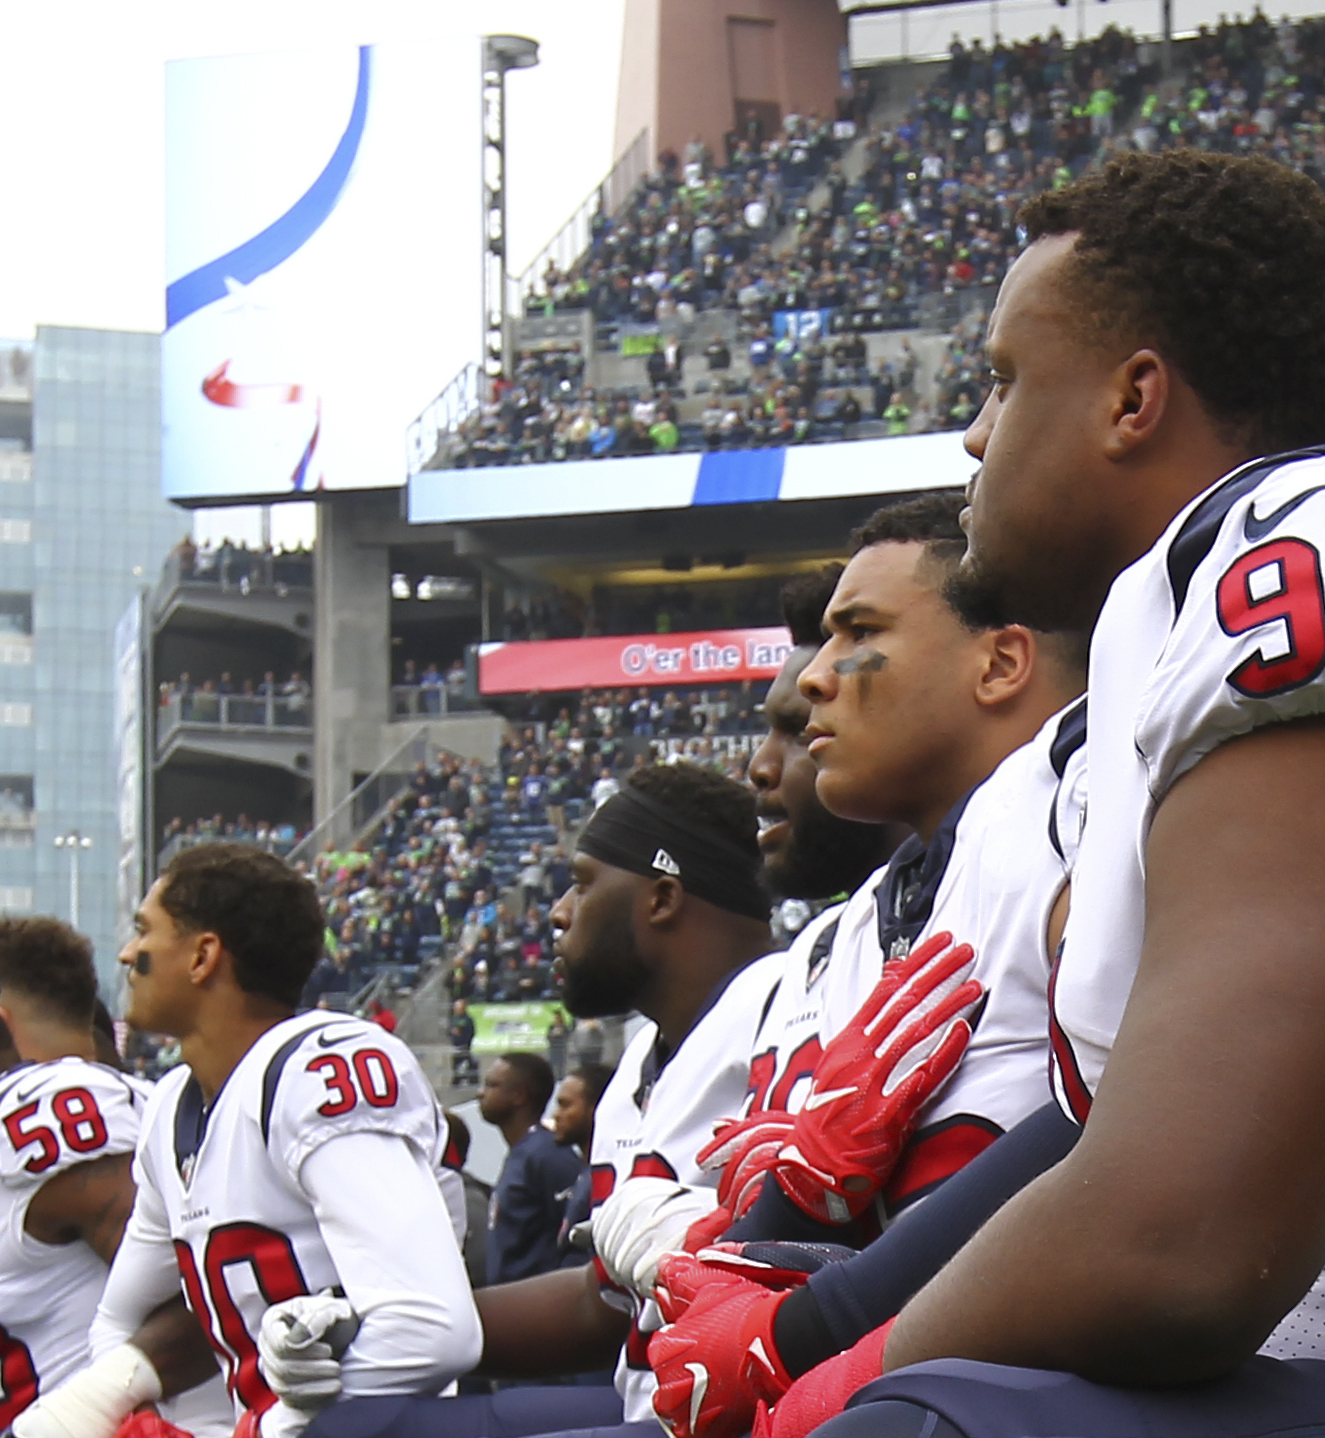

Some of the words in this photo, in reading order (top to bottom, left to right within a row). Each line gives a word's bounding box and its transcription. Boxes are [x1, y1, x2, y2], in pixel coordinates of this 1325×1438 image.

[621, 643, 686, 676] O'er
[690, 640, 742, 671] the
[305, 1048, 399, 1118] 30
[2, 1086, 108, 1172] 58
